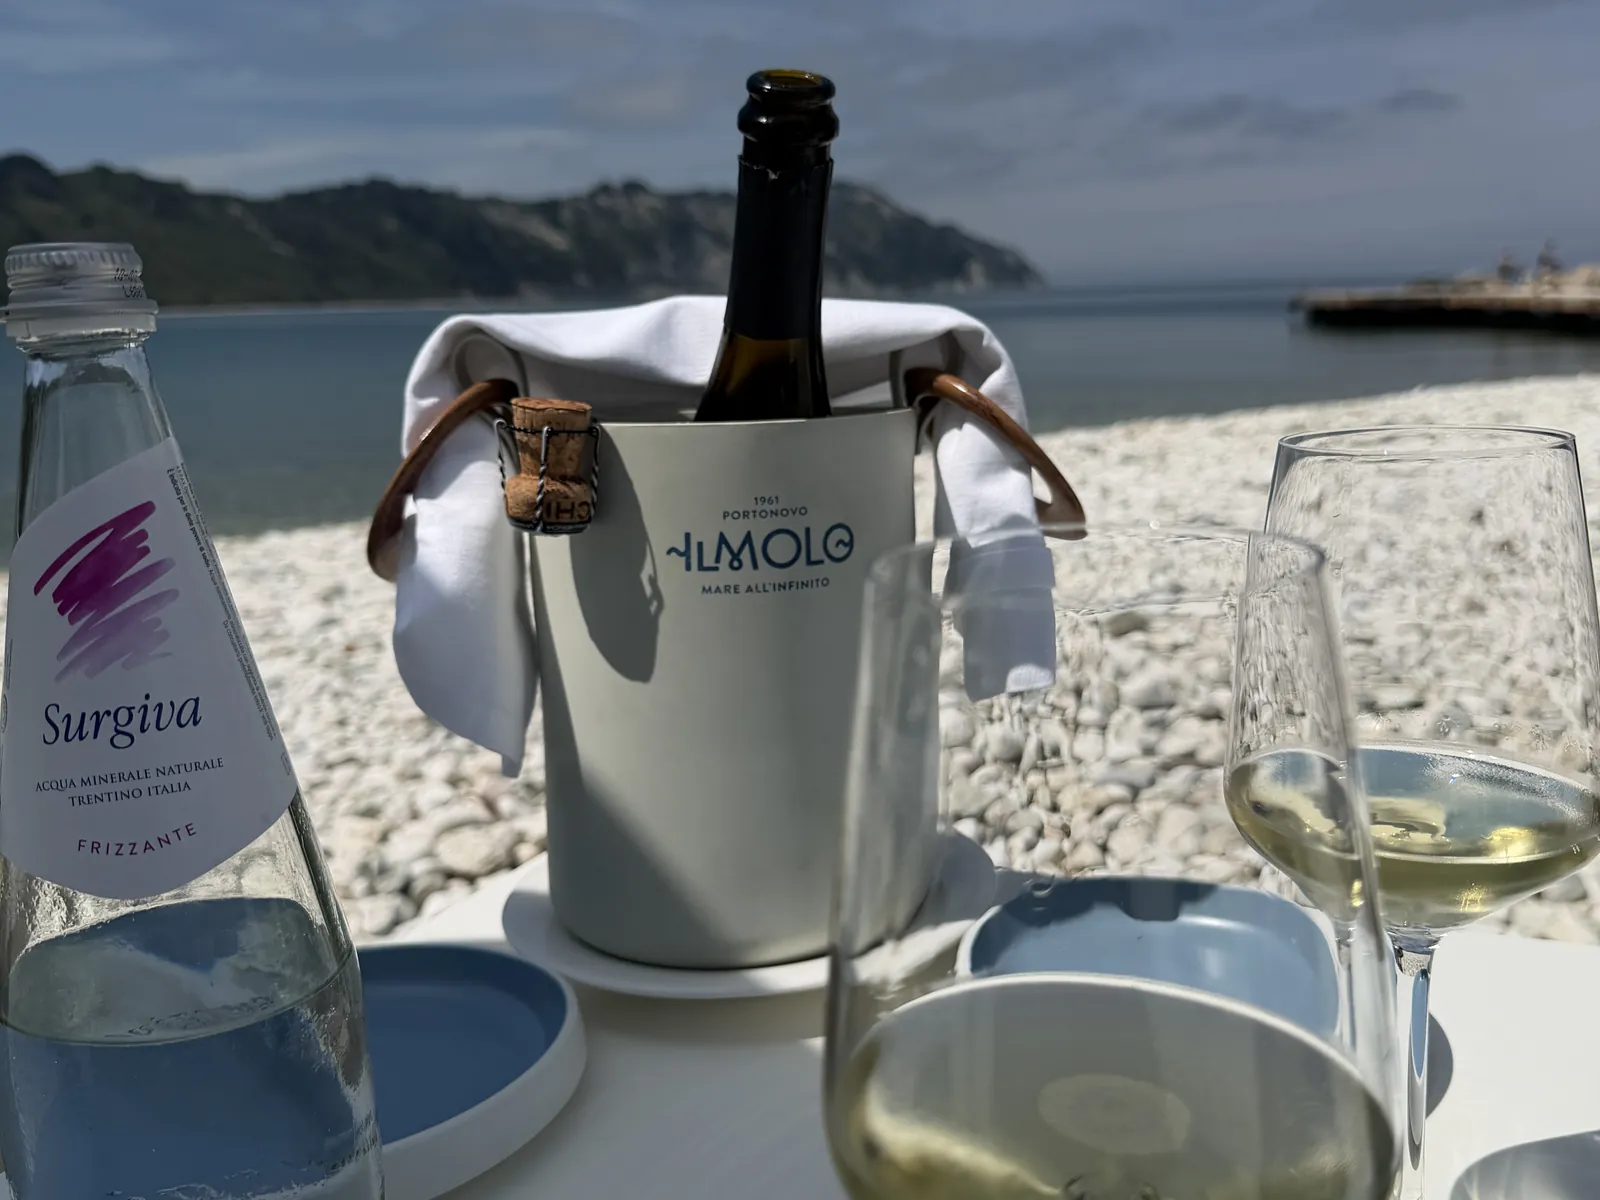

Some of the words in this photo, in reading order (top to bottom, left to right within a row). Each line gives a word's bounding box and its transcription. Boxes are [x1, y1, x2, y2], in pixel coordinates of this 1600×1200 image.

[722, 506, 809, 521] PORTONOVO
[753, 495, 780, 506] 1961
[702, 584, 741, 595] MARE
[745, 577, 830, 594] ALL'INFINITO
[42, 693, 203, 750] Surgiva
[35, 778, 77, 793] ACQUA
[80, 768, 151, 788] MINERALE
[156, 757, 224, 778] NATURALE
[68, 787, 143, 807] TRENTINO
[147, 781, 192, 797] ITALIA
[77, 822, 197, 856] FRIZZANTE
